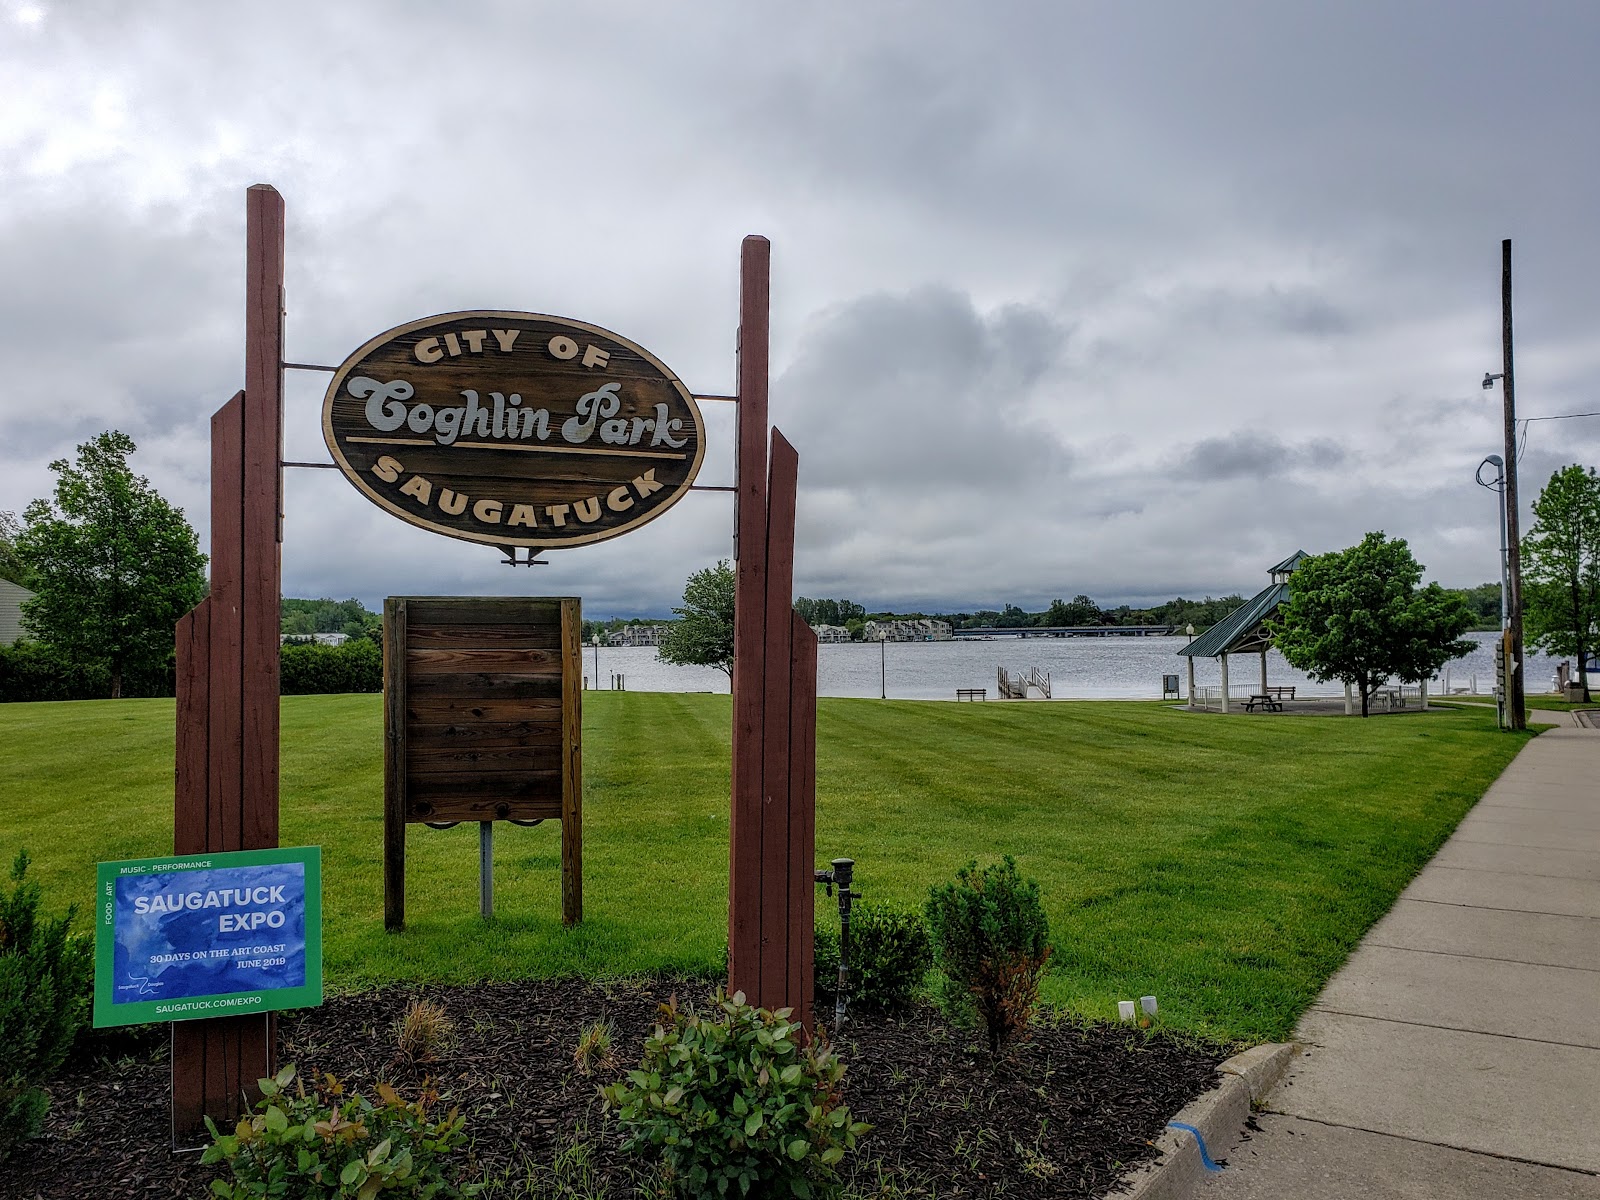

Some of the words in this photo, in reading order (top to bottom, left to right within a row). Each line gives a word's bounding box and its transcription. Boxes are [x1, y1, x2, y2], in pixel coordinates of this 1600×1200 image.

[414, 329, 521, 363] CITY
[548, 335, 611, 369] OF
[346, 376, 551, 446] Coghlin
[561, 382, 689, 448] Park
[371, 455, 665, 529] SAUGATUCK
[120, 865, 146, 874] MUSIC
[152, 860, 212, 872] PERFORMANCE
[105, 881, 113, 896] ART
[134, 885, 286, 915] SAUGATUCK
[105, 902, 113, 925] FOOD
[219, 910, 286, 933] EXPO
[150, 955, 163, 964] 30
[164, 952, 191, 963] DAYS
[192, 951, 207, 959] ON
[209, 949, 230, 958] THE
[231, 947, 251, 956] ART
[253, 943, 286, 954] COAST
[236, 960, 262, 970] JUNE
[263, 957, 286, 968] 2019
[155, 996, 262, 1014] SAUGATUCK.COM/EXPO
